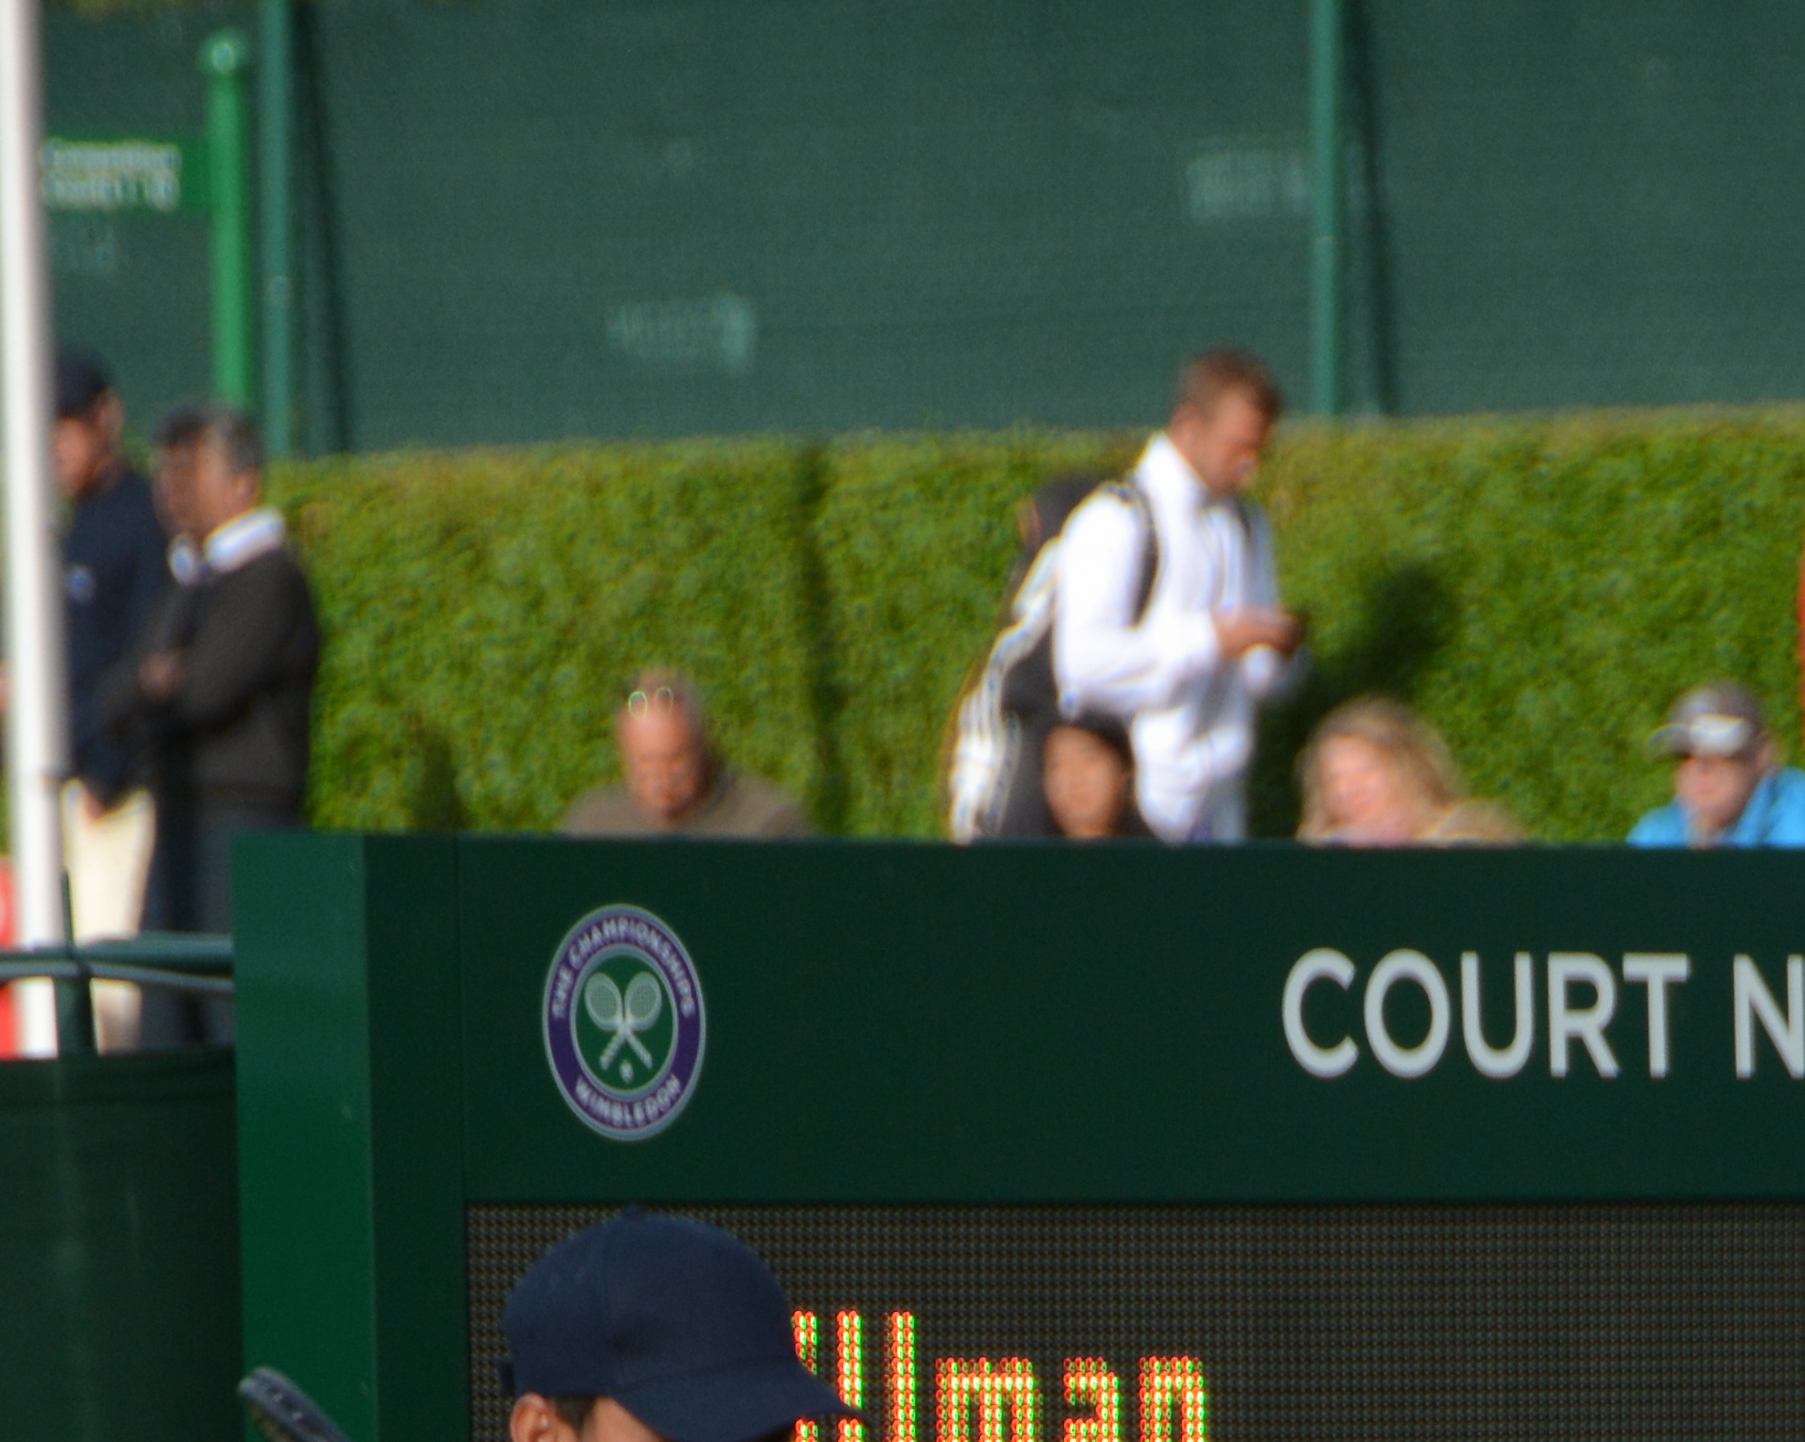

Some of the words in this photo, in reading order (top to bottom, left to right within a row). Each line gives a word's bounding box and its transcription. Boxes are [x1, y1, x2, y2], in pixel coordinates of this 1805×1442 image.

[551, 962, 574, 1021] THE
[568, 916, 696, 1019] CHAMPIONSHIPS
[1281, 947, 1691, 1081] COURT
[573, 1072, 682, 1129] WIMBLEDON
